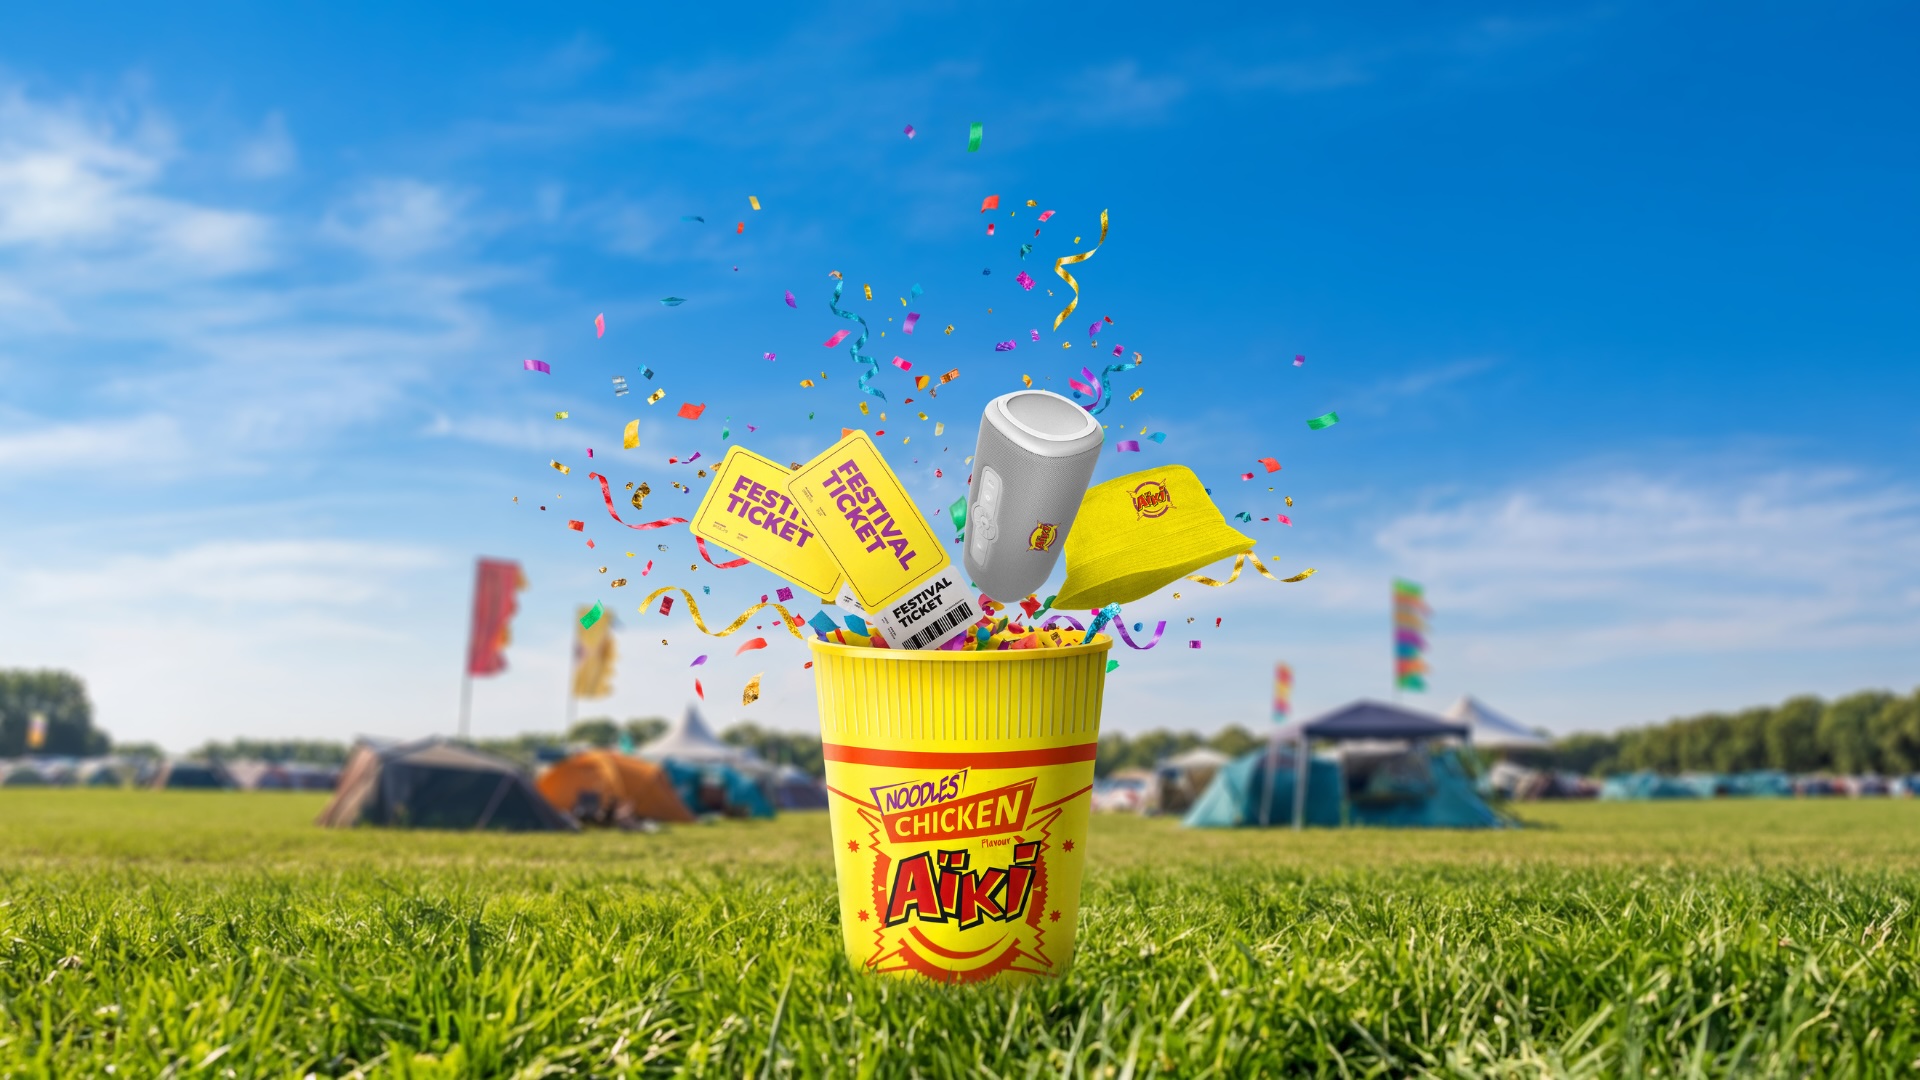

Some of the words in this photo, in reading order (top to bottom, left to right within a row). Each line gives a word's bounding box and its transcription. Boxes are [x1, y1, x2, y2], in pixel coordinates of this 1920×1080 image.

[726, 493, 814, 548] TICKET
[822, 469, 887, 554] TICKET
[837, 458, 917, 571] FESTIVAL
[892, 577, 952, 619] FESTIVAL
[898, 594, 944, 628] TICKET
[886, 774, 960, 812] NOODLES
[895, 790, 1024, 837] CHICKEN
[981, 838, 1011, 848] Flavour
